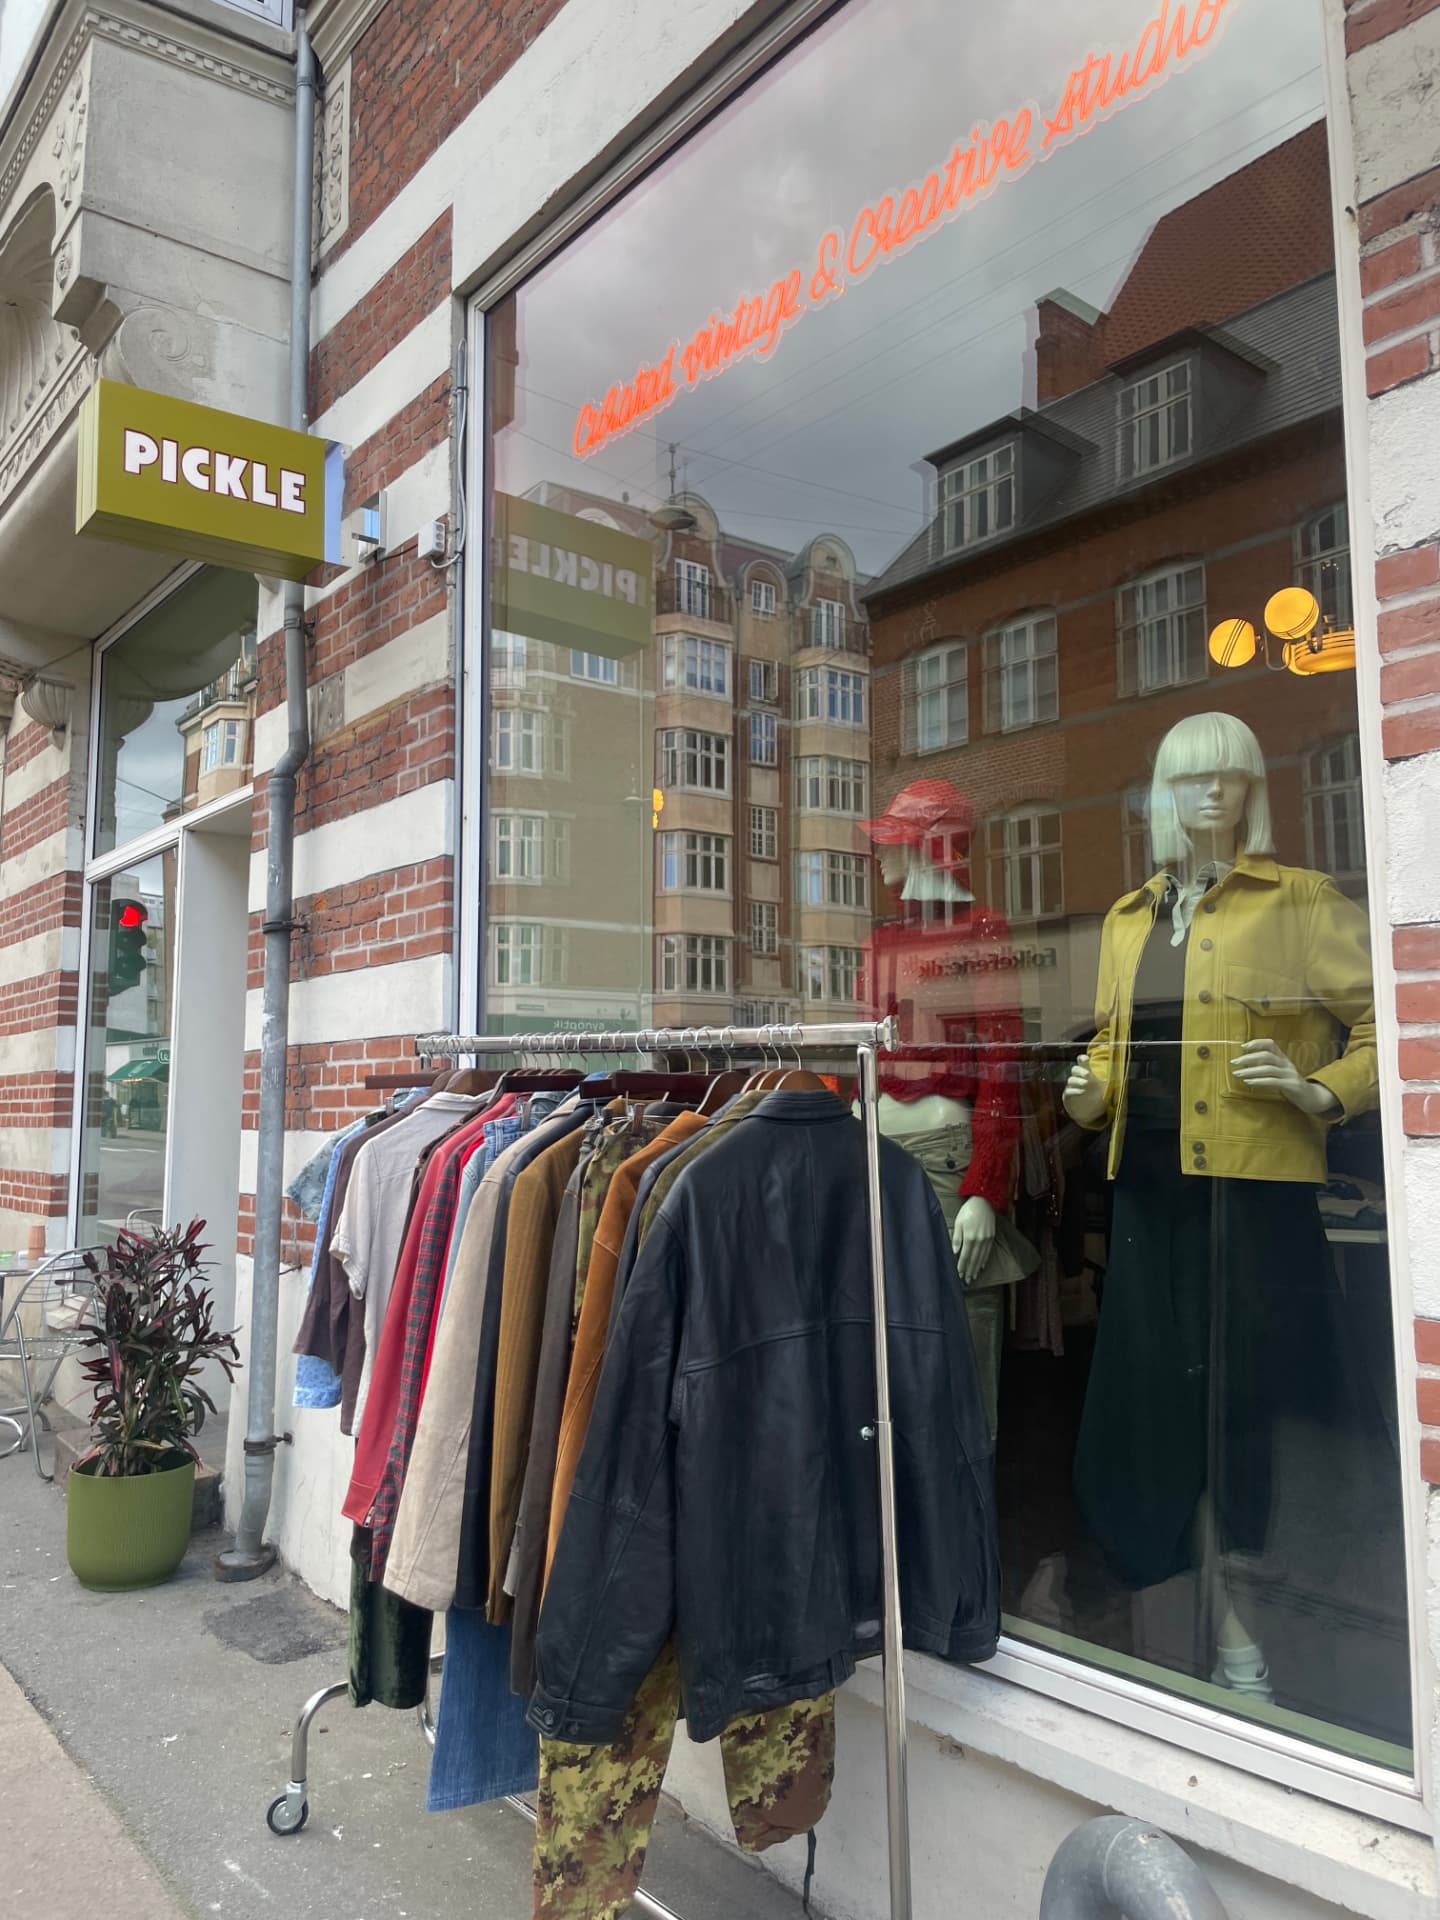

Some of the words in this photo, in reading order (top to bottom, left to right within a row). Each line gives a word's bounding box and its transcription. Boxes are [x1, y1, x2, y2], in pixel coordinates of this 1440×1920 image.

[573, 344, 676, 456] Curated
[679, 269, 801, 382] vintage
[809, 231, 844, 301] &
[848, 107, 1032, 275] Creative
[1040, 0, 1230, 149] studio
[124, 427, 306, 514] PICKLE
